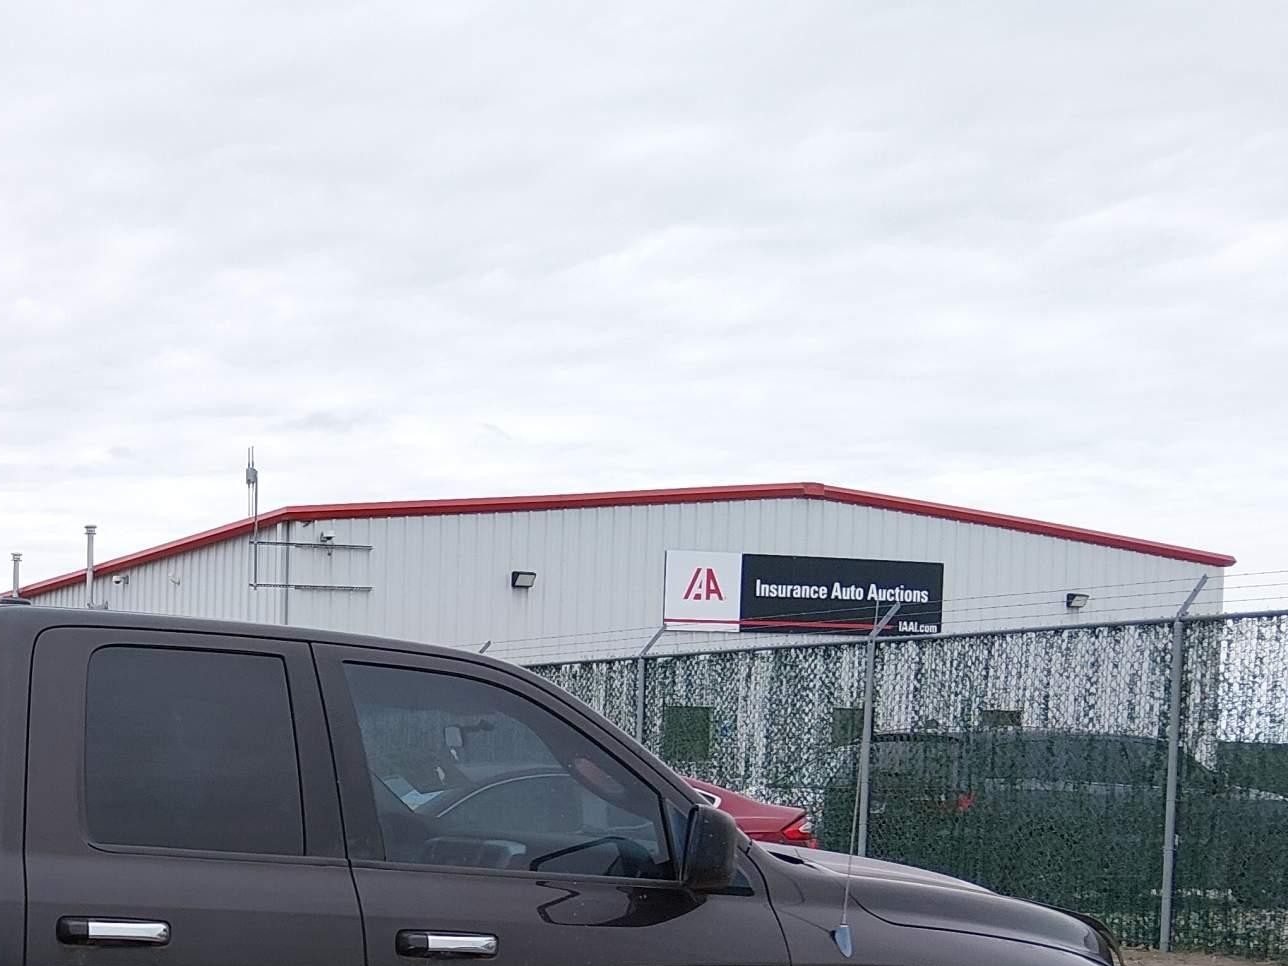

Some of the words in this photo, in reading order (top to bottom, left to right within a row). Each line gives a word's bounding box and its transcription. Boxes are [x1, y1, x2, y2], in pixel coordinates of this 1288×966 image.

[755, 579, 828, 599] Insurance
[831, 582, 864, 601] Auto
[866, 583, 929, 603] Auctions
[898, 620, 938, 634] IAAI.com
